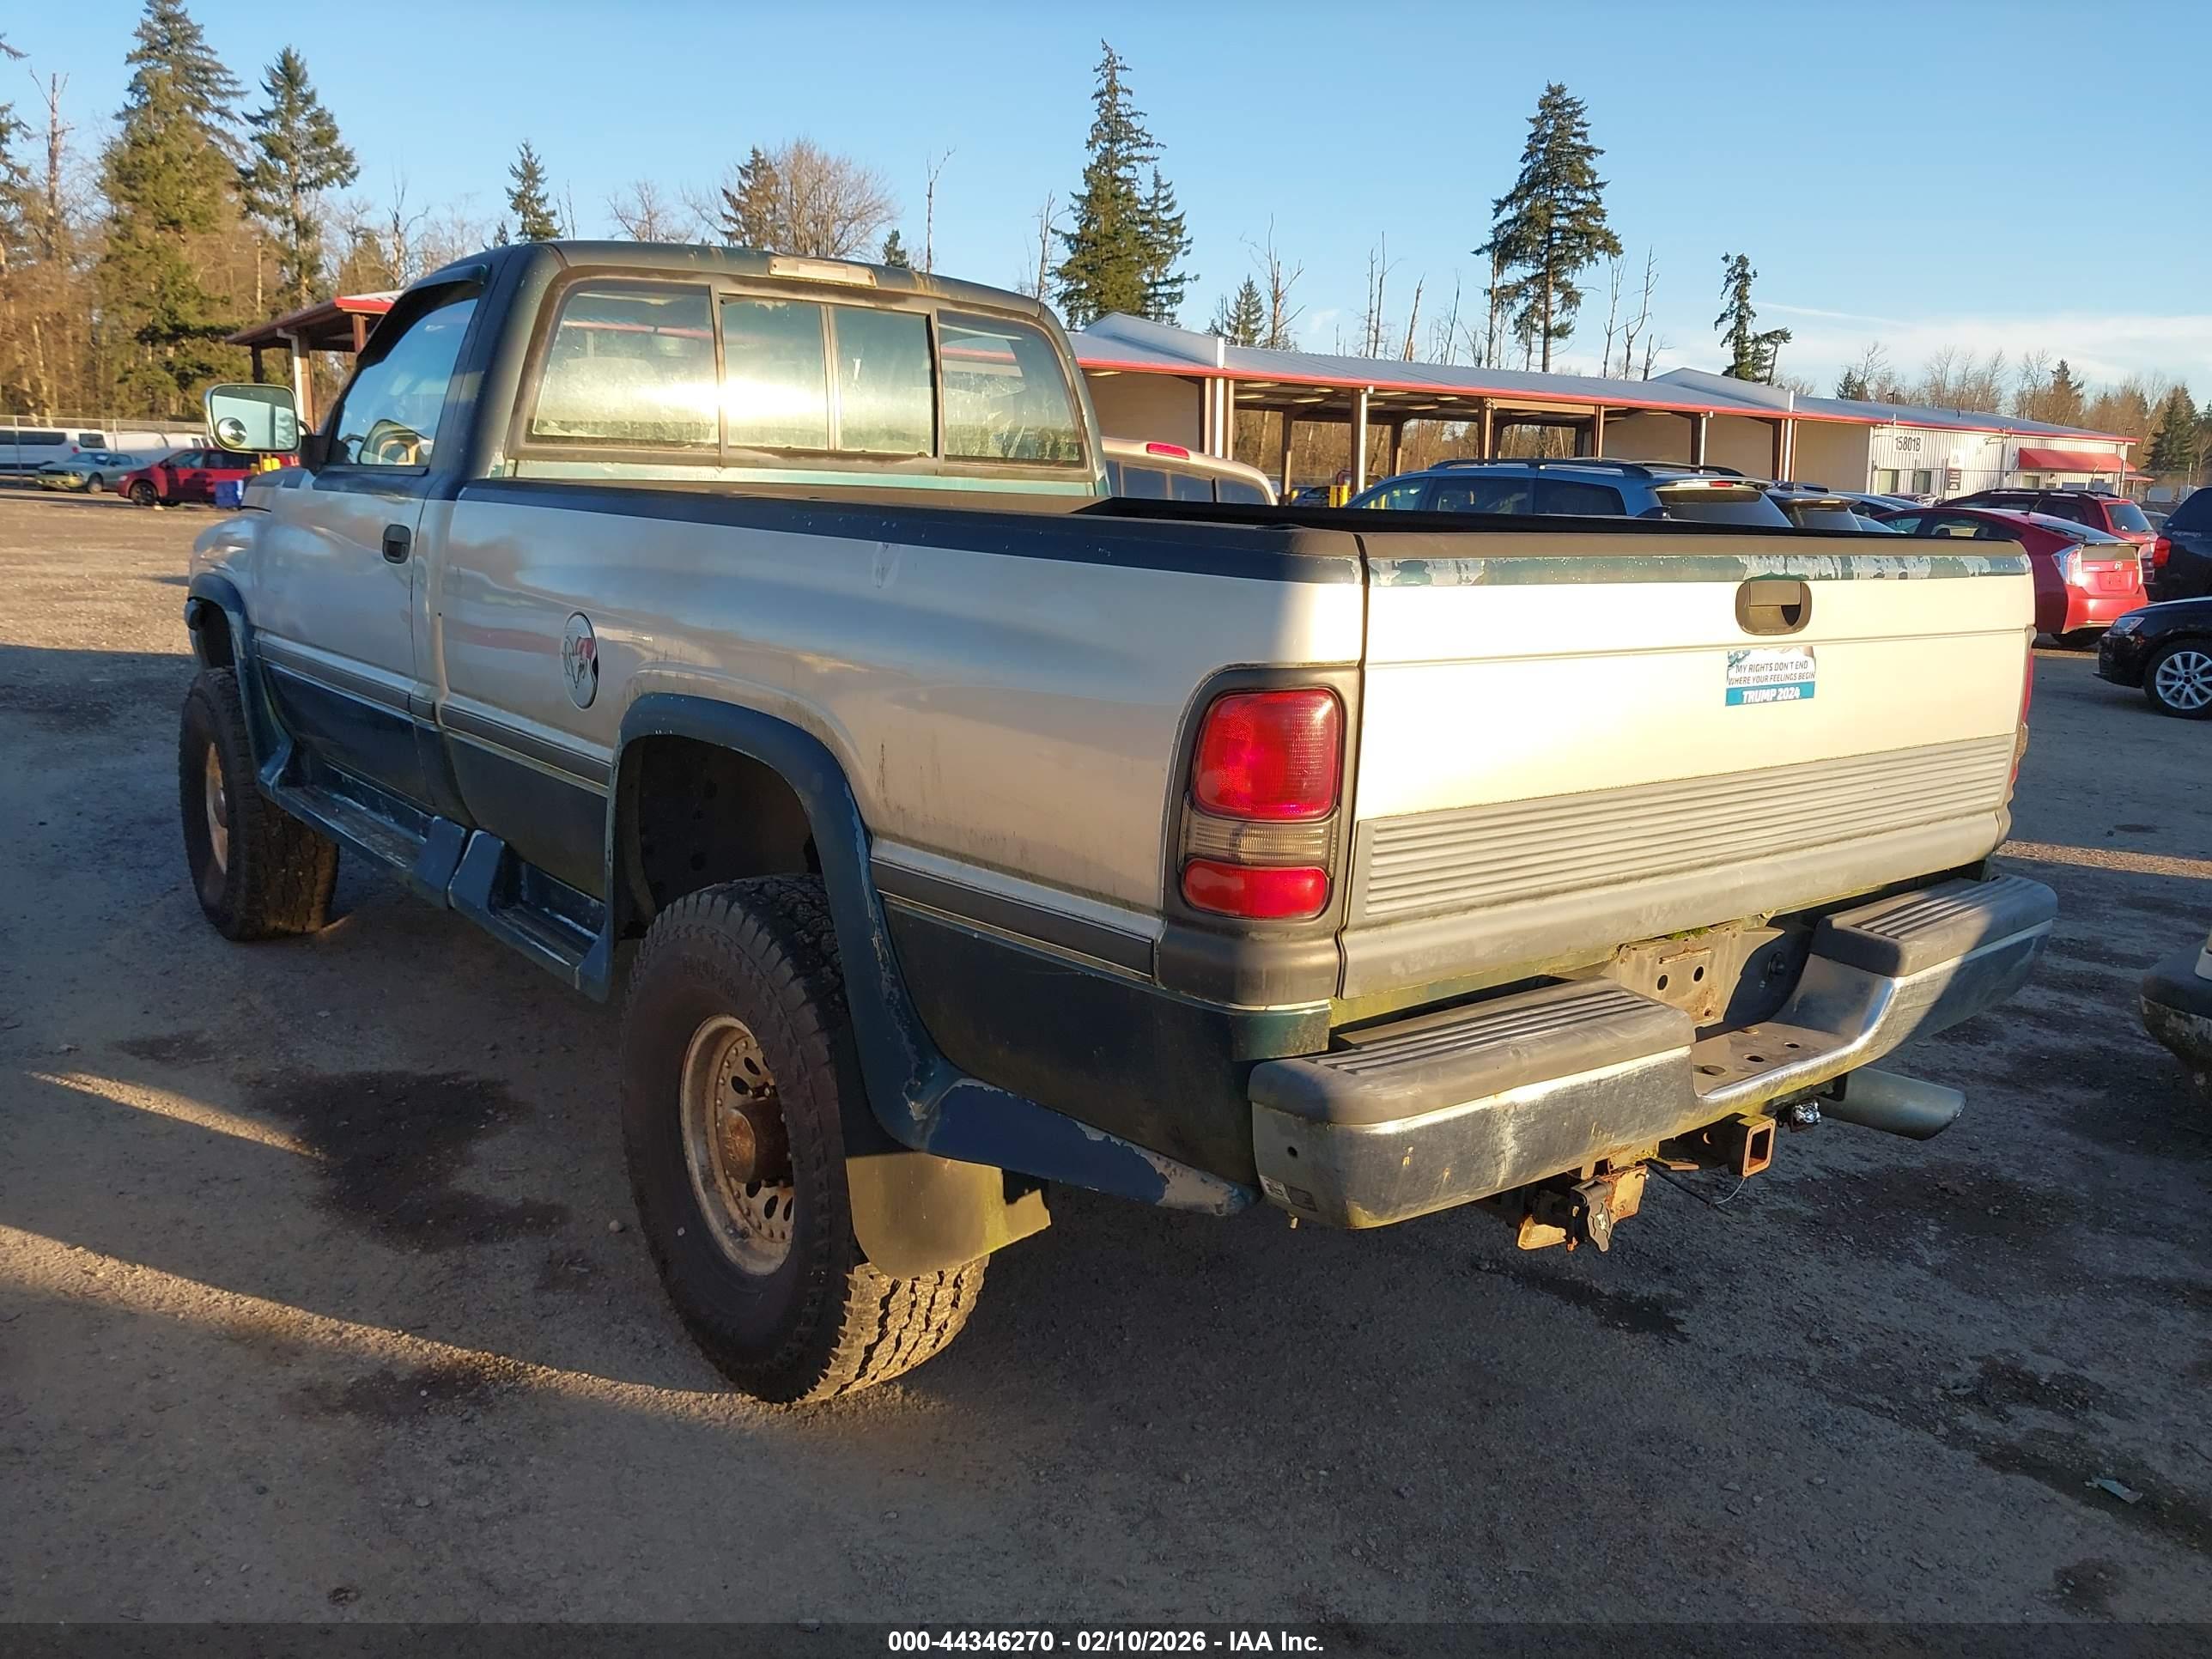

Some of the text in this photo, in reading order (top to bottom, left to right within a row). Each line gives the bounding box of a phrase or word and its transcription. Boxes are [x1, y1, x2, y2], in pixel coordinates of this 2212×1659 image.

[1895, 435, 1921, 452] 15801B
[1735, 659, 1808, 674] MY RIGHTS DON'T END
[1728, 671, 1815, 686] WHERE YOUR FEELINGS BEGIN
[1742, 686, 1801, 703] TRUMP 2024
